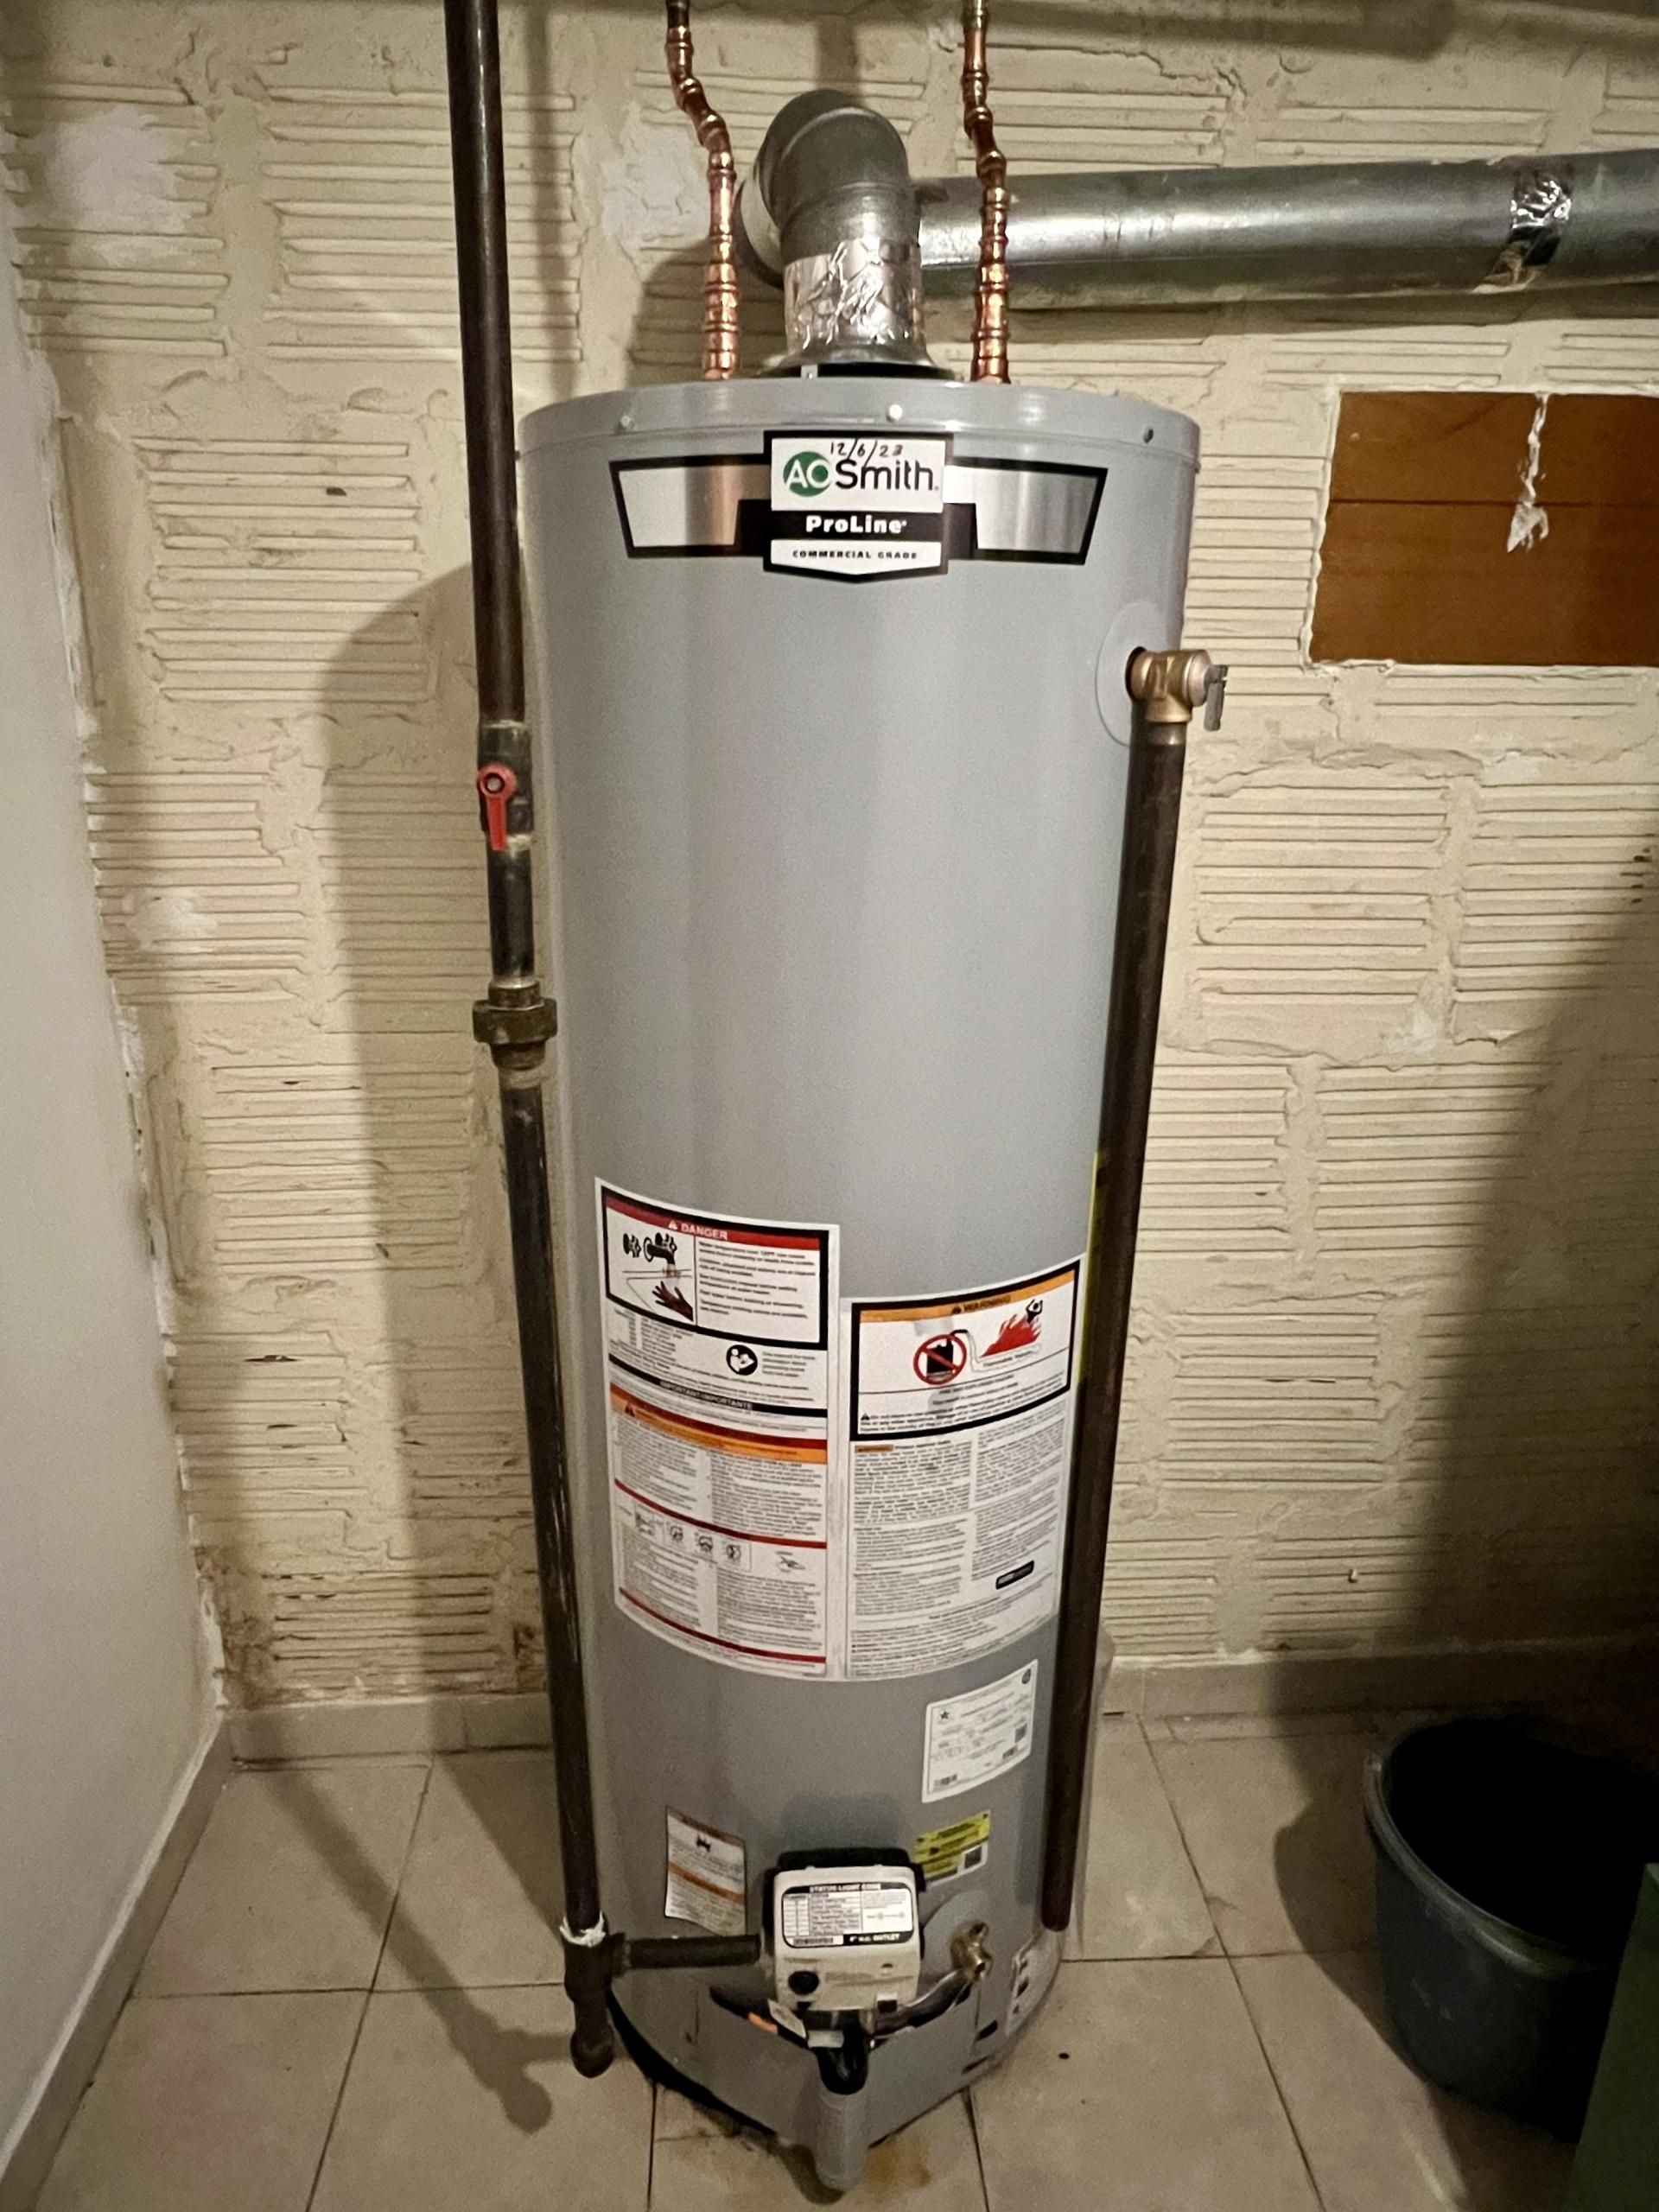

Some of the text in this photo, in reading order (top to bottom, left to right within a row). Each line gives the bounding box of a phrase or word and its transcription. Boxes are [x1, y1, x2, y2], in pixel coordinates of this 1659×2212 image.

[836, 460, 933, 491] Smith
[792, 550, 871, 559] COMMERCIAL
[681, 1224, 728, 1241] DANGER
